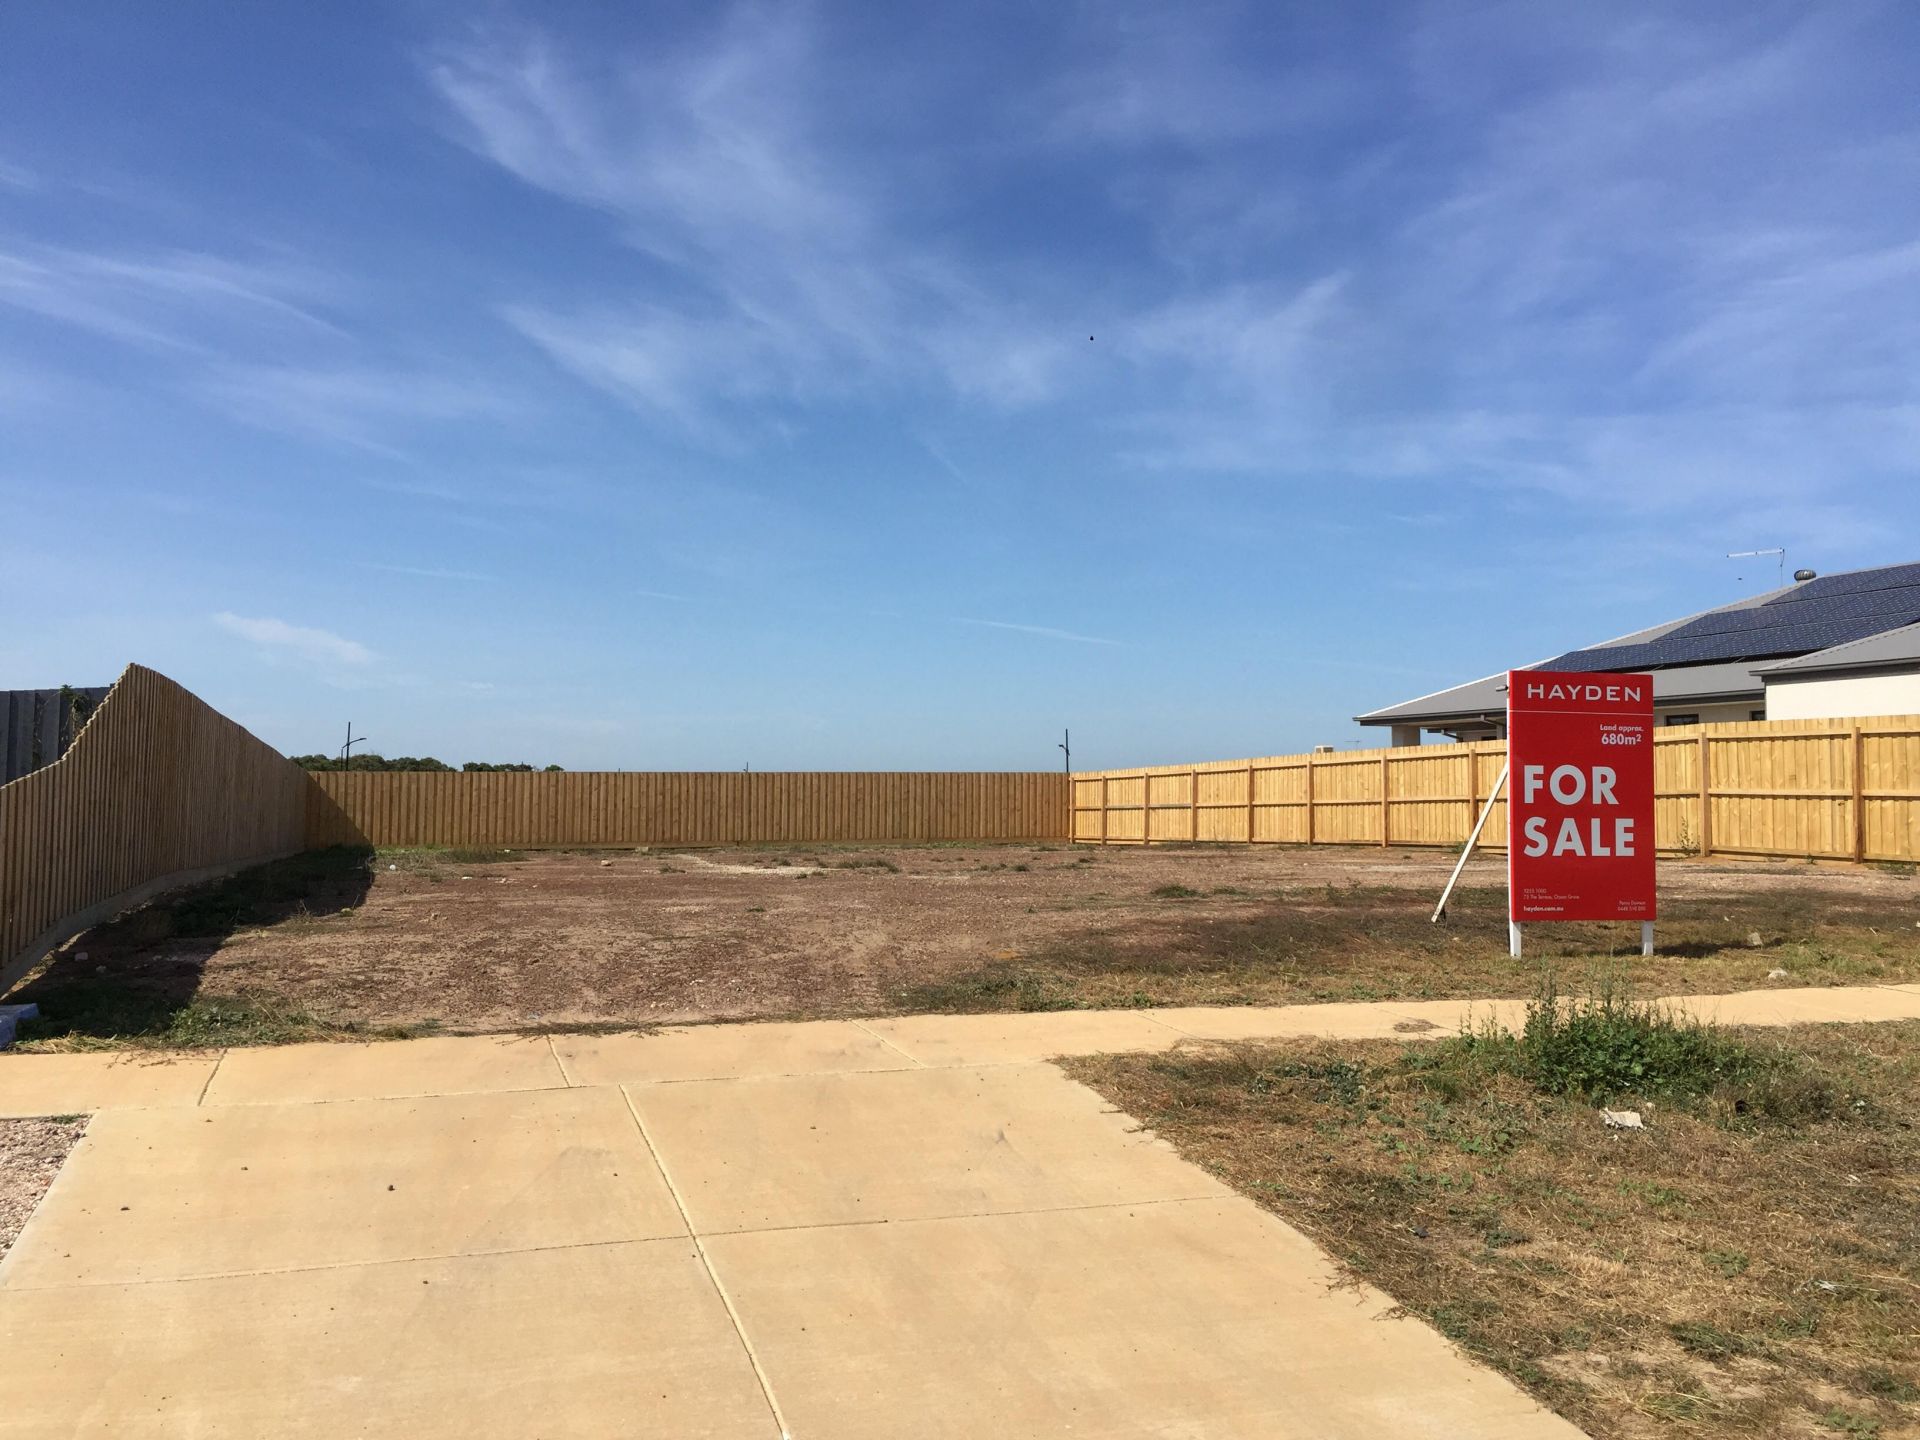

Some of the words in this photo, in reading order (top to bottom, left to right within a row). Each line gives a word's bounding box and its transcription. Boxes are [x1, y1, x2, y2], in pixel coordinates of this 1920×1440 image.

[1528, 684, 1641, 702] HAYDEN
[1524, 764, 1619, 805] FOR
[1523, 817, 1635, 857] SALE
